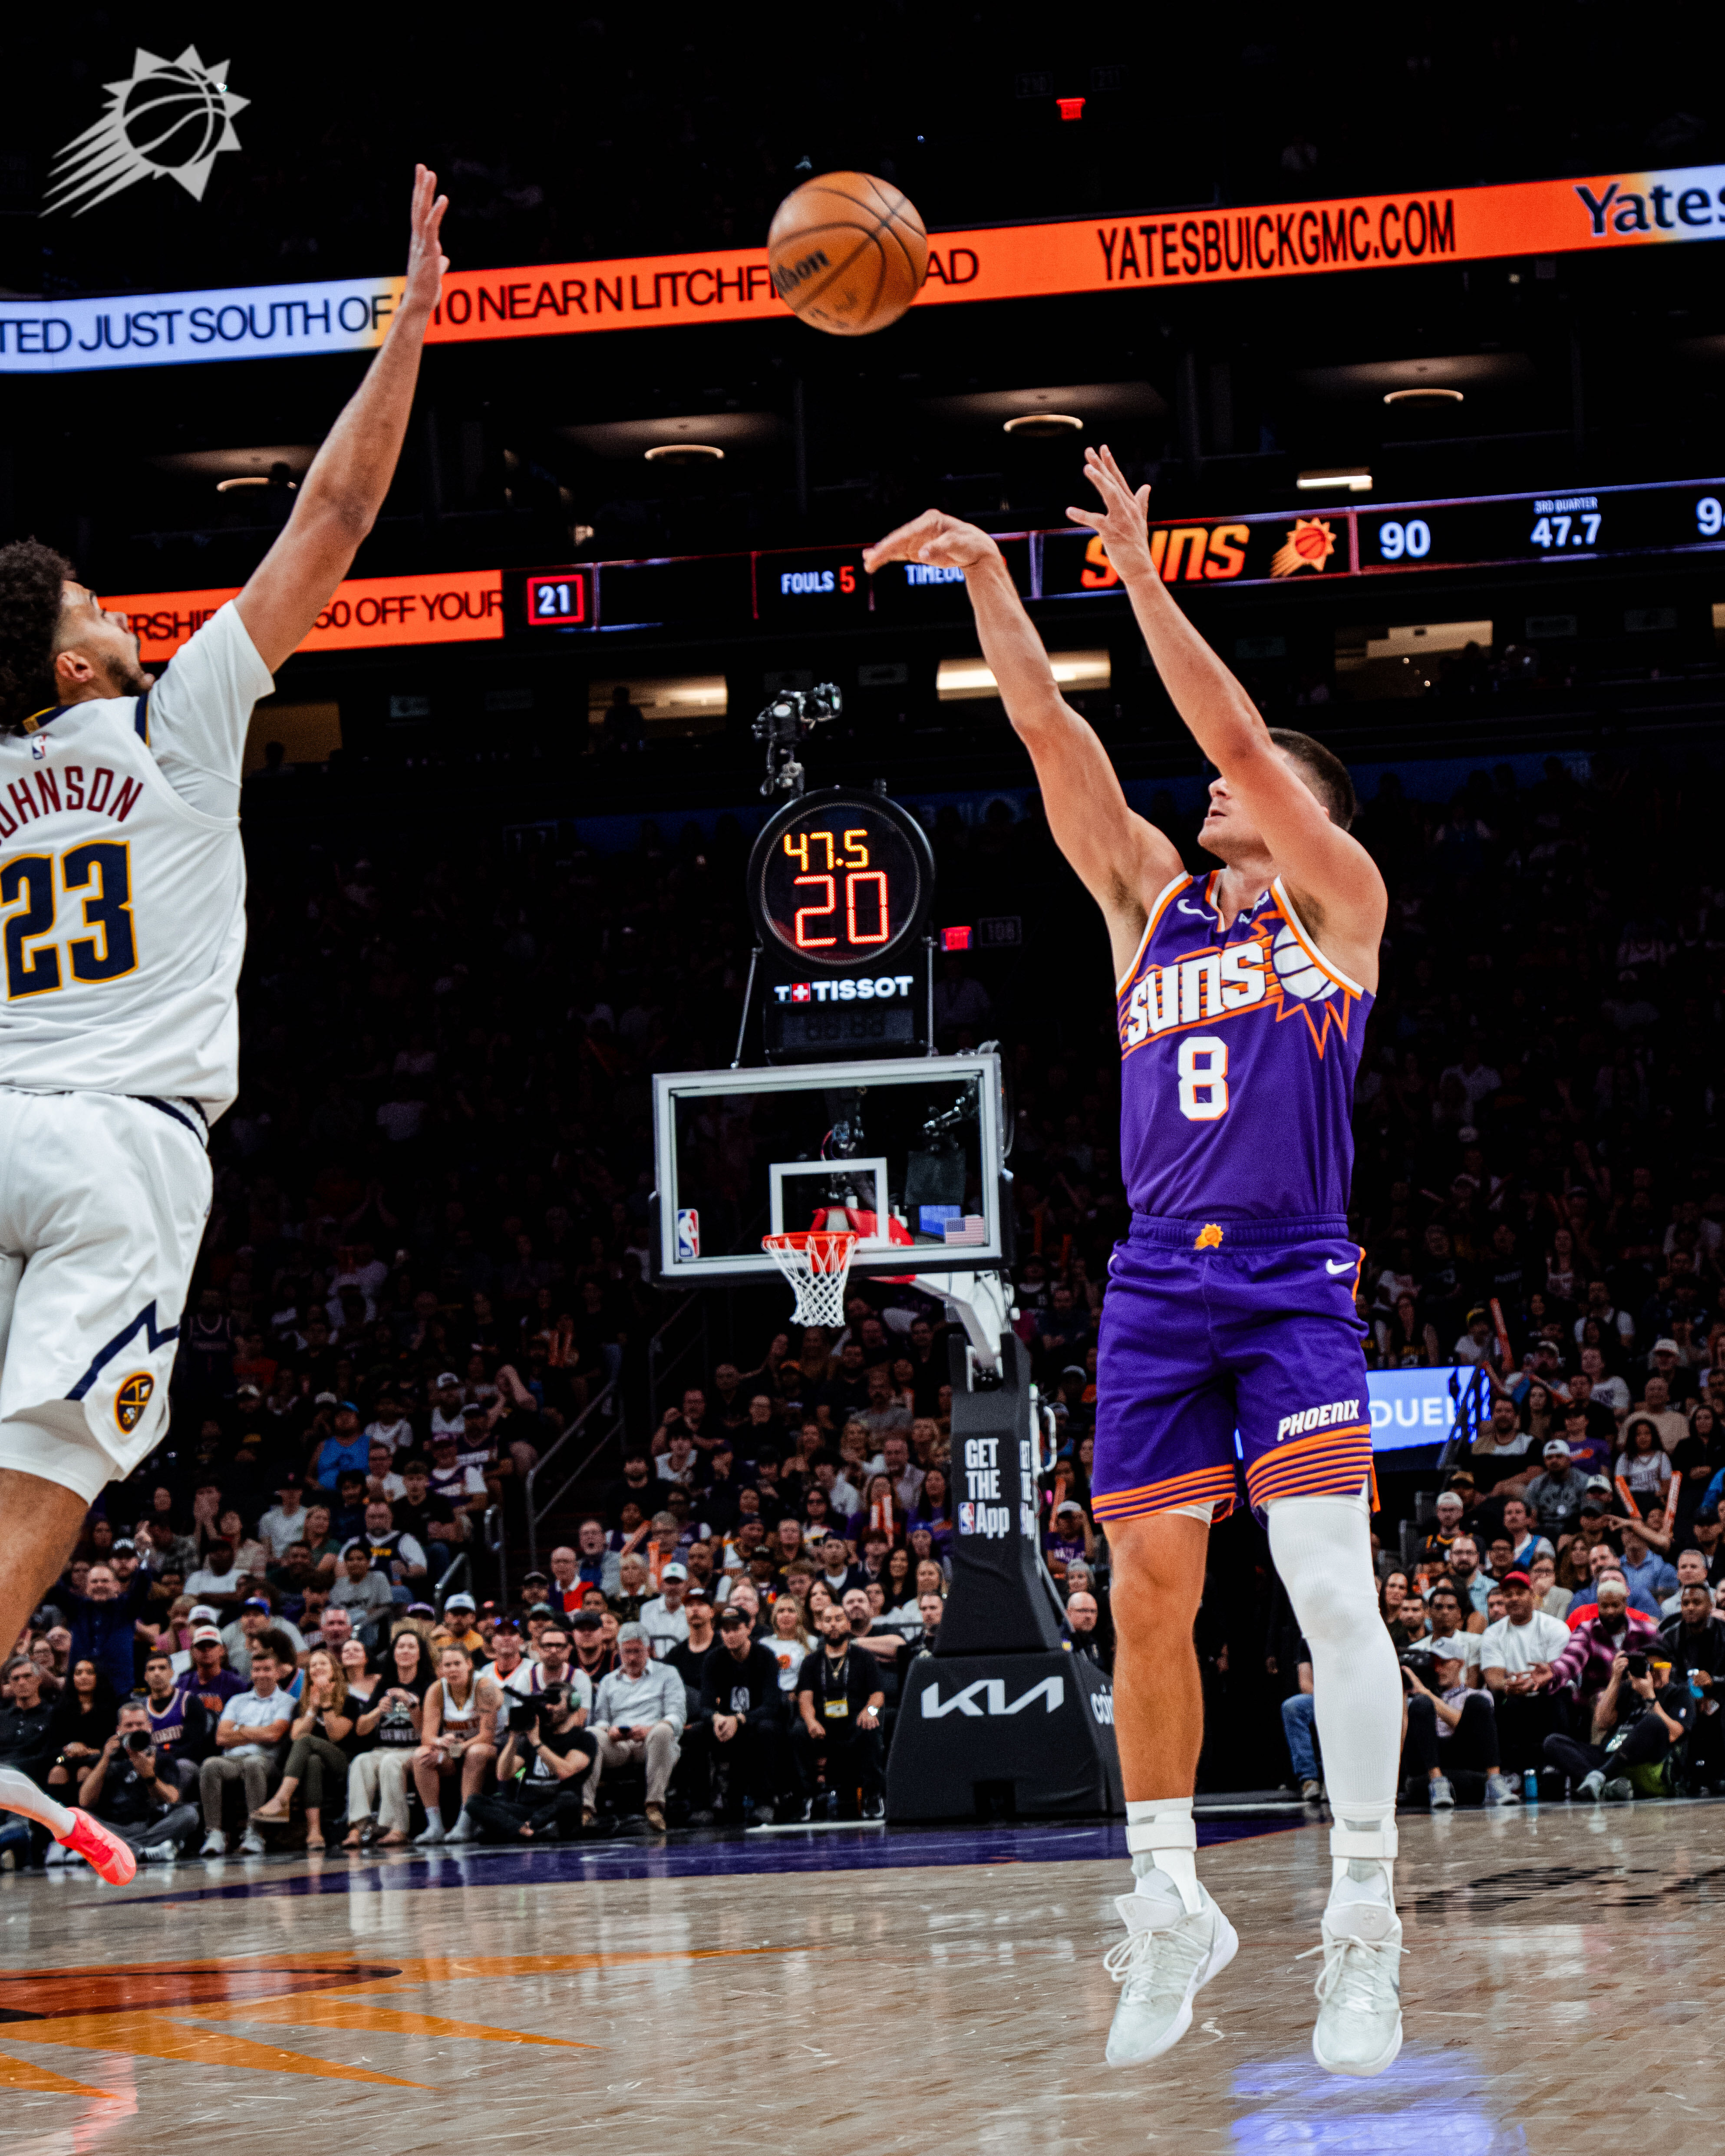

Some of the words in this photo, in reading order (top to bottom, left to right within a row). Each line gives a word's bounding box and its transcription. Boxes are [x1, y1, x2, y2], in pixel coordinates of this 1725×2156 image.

[1097, 199, 1456, 280] YATESBUICKGMC.COM
[78, 310, 183, 351] JUST
[189, 298, 330, 343] SOUTH
[339, 295, 392, 332] OF
[478, 280, 588, 322] NEAR
[595, 276, 623, 313] N
[631, 265, 777, 310] LITCHFI
[1554, 496, 1598, 513] QUARTER
[1696, 497, 1725, 536] 9
[1379, 519, 1431, 560] 90
[1530, 514, 1601, 548] 47.7
[781, 570, 834, 594] FOULS
[839, 566, 855, 593] 5
[904, 564, 965, 586] TIMEOU
[356, 596, 416, 626] OFF
[538, 584, 570, 615] 21
[0, 765, 144, 841] OHNSON
[784, 829, 869, 871] 47.5
[0, 840, 139, 1001] 23
[794, 870, 889, 947] 20
[811, 975, 914, 1002] TISSOT
[1128, 942, 1266, 1046] SUNS
[1177, 1036, 1229, 1121] 8
[1277, 1399, 1360, 1442] PHOENIX
[965, 1438, 999, 1469] GET
[965, 1469, 1001, 1500] THE
[976, 1502, 1010, 1539] App
[921, 1676, 1064, 1719] KIA
